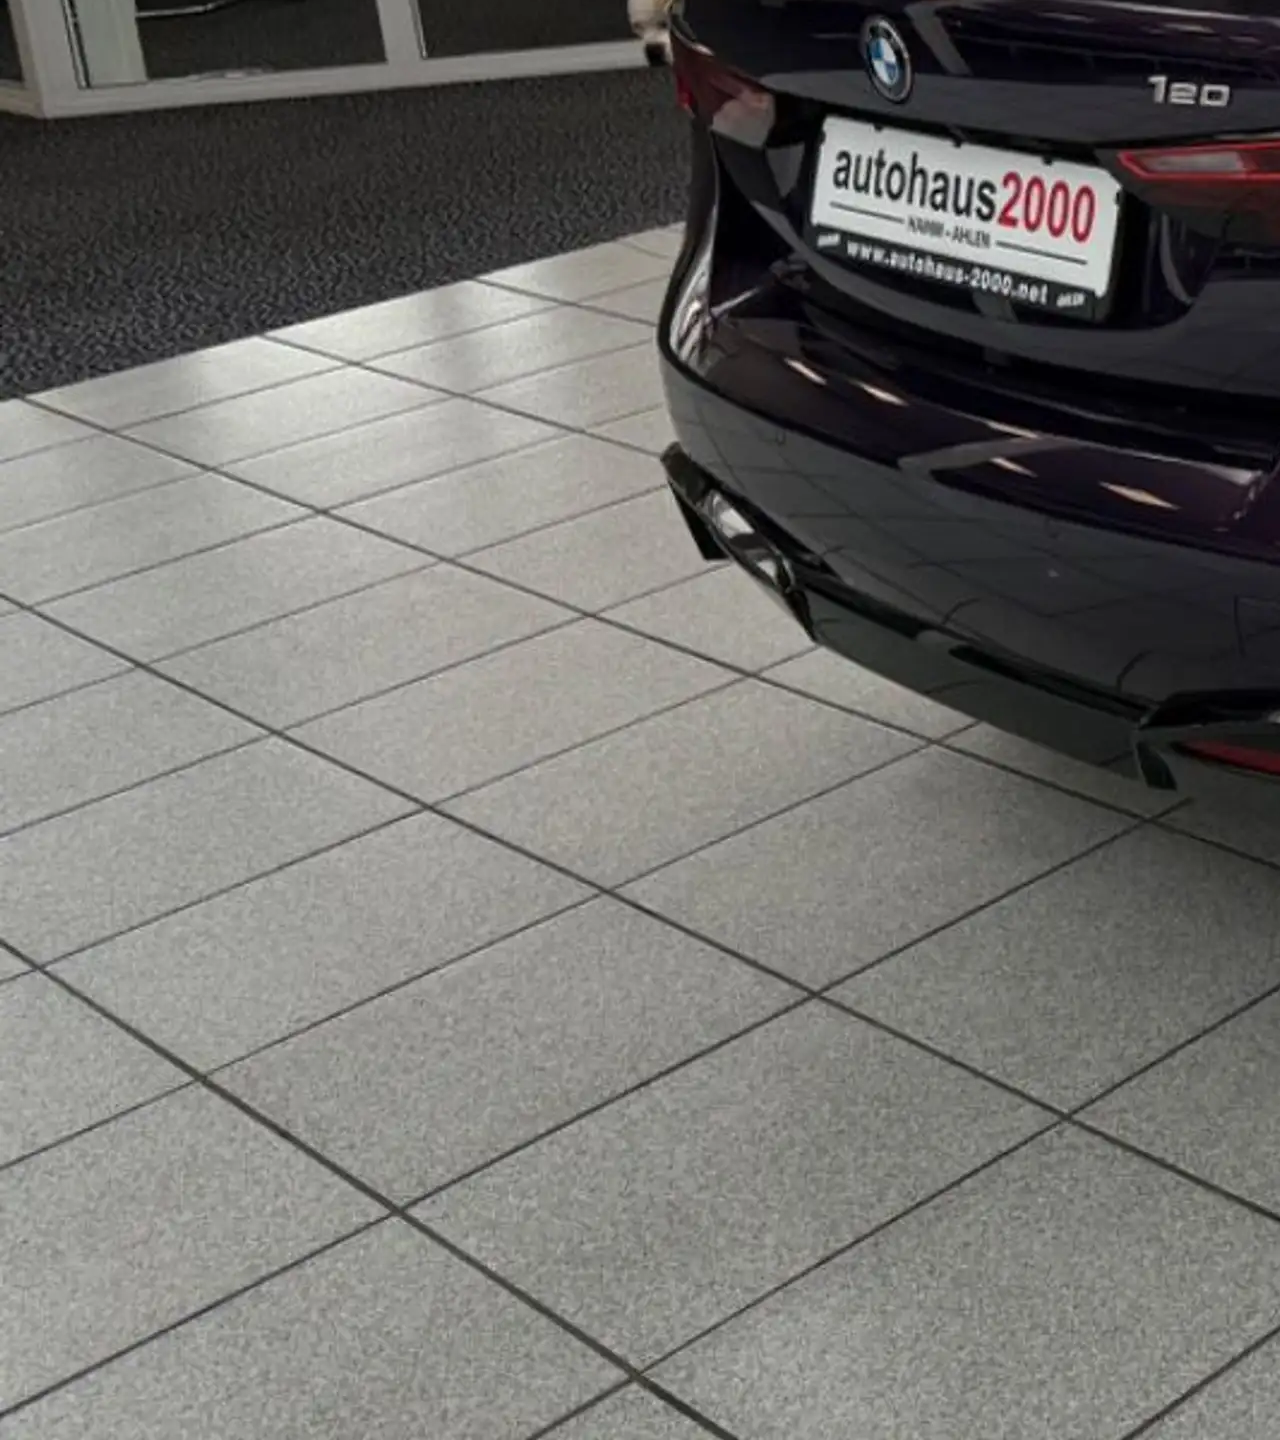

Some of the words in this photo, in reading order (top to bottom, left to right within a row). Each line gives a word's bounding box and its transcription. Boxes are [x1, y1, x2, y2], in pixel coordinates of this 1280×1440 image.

[1147, 74, 1231, 107] 120
[832, 148, 1096, 244] autohaus2000
[846, 239, 1048, 306] www.autohaus-2000.net
